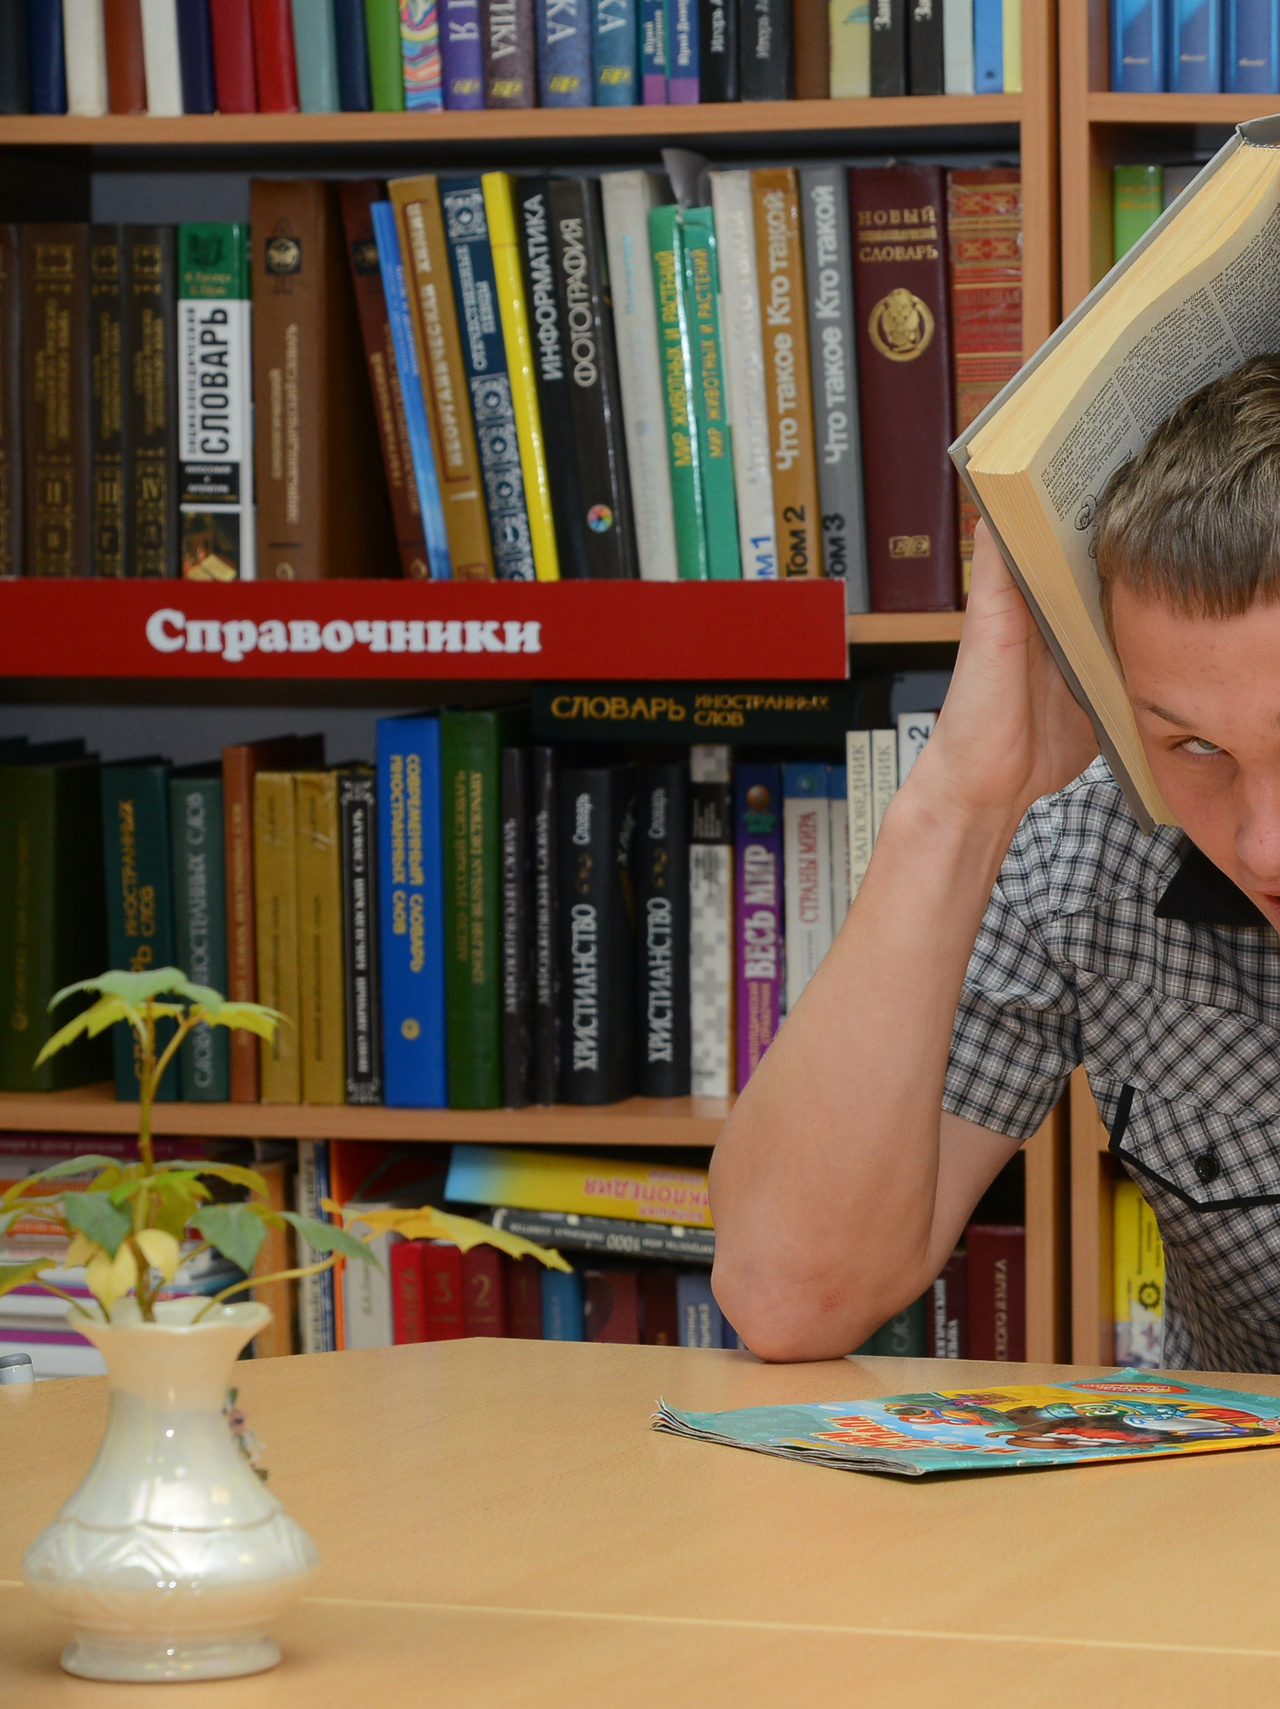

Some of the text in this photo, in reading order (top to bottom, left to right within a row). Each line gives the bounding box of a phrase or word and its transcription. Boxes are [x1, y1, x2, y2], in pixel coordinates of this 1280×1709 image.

[857, 205, 937, 225] НОВЫЙ
[859, 245, 939, 262] СЛОВАРЬ
[405, 202, 464, 469] НЕОРГАНИЧЕСКАЯ ХИМИЯ
[523, 193, 565, 381] ИНФОРМАТИКА
[560, 217, 598, 388] ФОТОГРАФИЯ
[690, 248, 724, 458] МИР ЖИВОТНЫХ И РАСТЕНИЙ
[763, 190, 800, 471] Что такое Кто такой
[813, 184, 849, 465] Что такое Кто такой
[201, 308, 228, 455] СЛОВАРЬ
[654, 249, 692, 467] МИР ЖИВОТНЫХ И РАСТЕНИЙ
[783, 505, 807, 526] 2
[822, 512, 846, 533] 3
[145, 607, 542, 661] Справочники
[693, 694, 831, 711] ИНОСТРАННЫХ
[549, 695, 687, 722] СЛОВАРЬ
[693, 709, 745, 728] СЛОВ
[389, 754, 408, 936] ИНОСТРАННЫХ СЛОВ
[405, 753, 426, 973] СОВРЕМЕННЫЙ СЛОВАРЬ
[799, 811, 820, 925] СТРАНЫ МИРА
[852, 743, 868, 871] ЗАПОВЕДНИК
[571, 792, 598, 1071] ХРИСТИАНСТВО Словарь
[647, 787, 673, 1065] ХРИСТИАНСТВО Словарь
[744, 843, 777, 980] ВЕСЬ МИР
[434, 1271, 454, 1304] 3
[471, 1273, 493, 1308] 2
